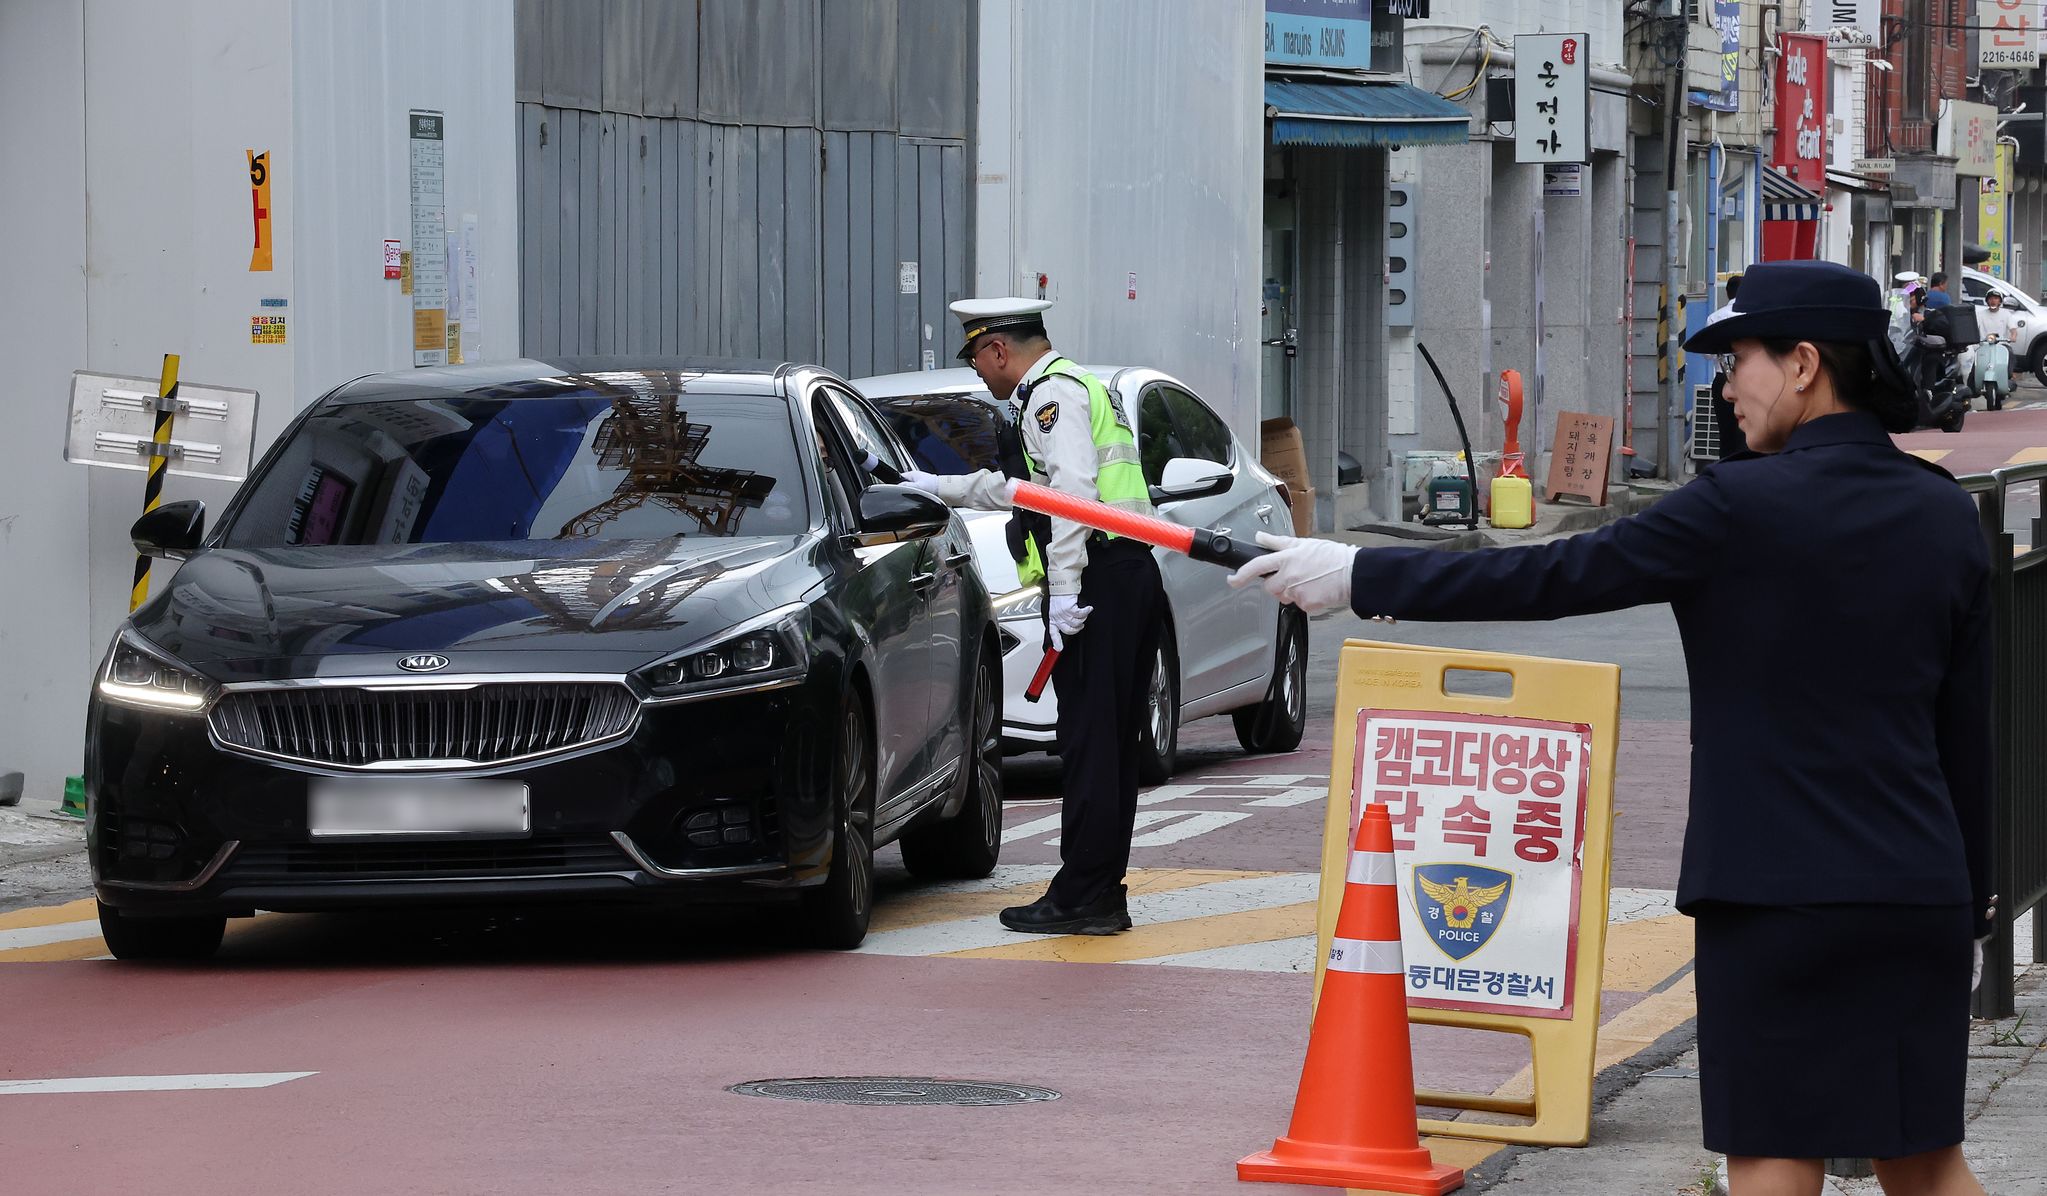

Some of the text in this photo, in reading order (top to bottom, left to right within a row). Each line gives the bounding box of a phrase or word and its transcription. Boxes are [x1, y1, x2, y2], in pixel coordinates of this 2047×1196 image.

[1982, 51, 2035, 63] 2216-4646
[406, 656, 440, 667] KIA
[1374, 727, 1572, 798] 캠코더영상
[1438, 928, 1480, 944] POLICE
[1408, 964, 1555, 1000] 동대문경찰서
